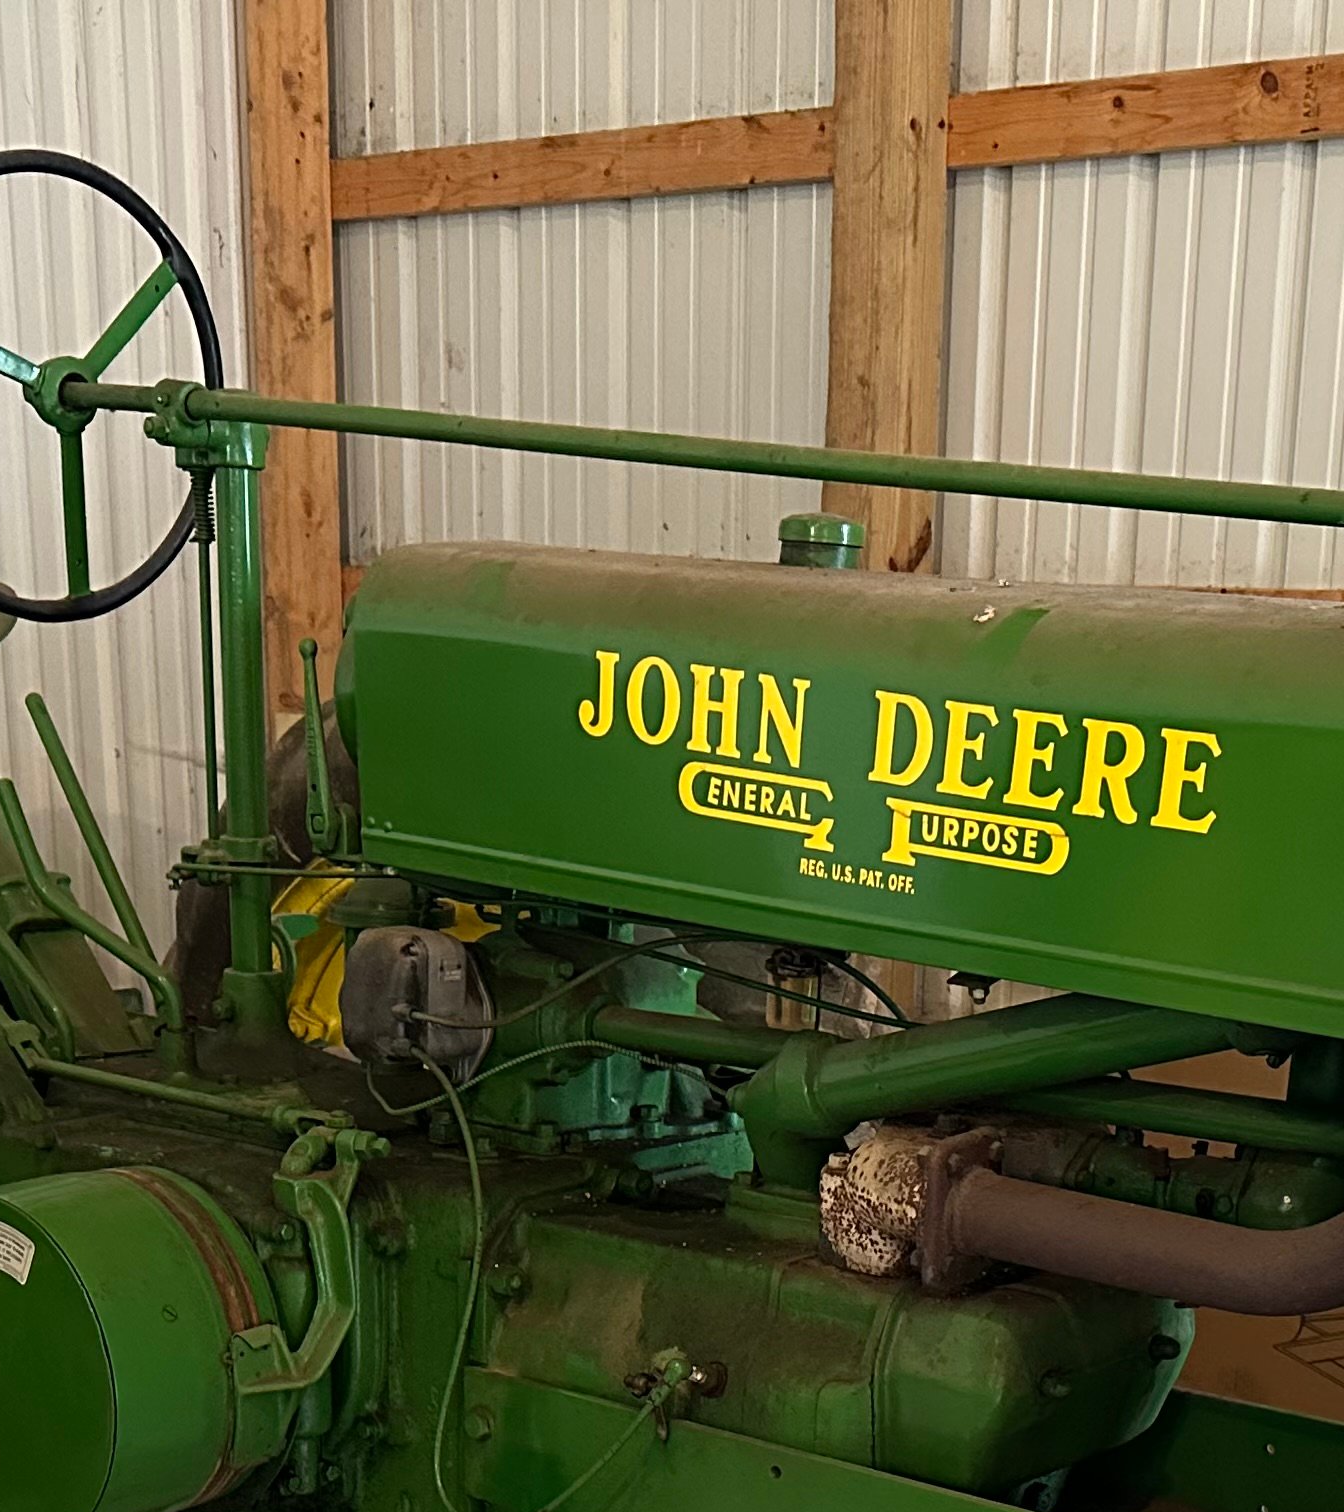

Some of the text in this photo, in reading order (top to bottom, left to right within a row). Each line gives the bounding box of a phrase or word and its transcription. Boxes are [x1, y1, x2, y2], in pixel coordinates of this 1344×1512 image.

[578, 649, 1222, 835] JOHN DEERE
[799, 857, 914, 894] REG. U.S. PAT. OFF.
